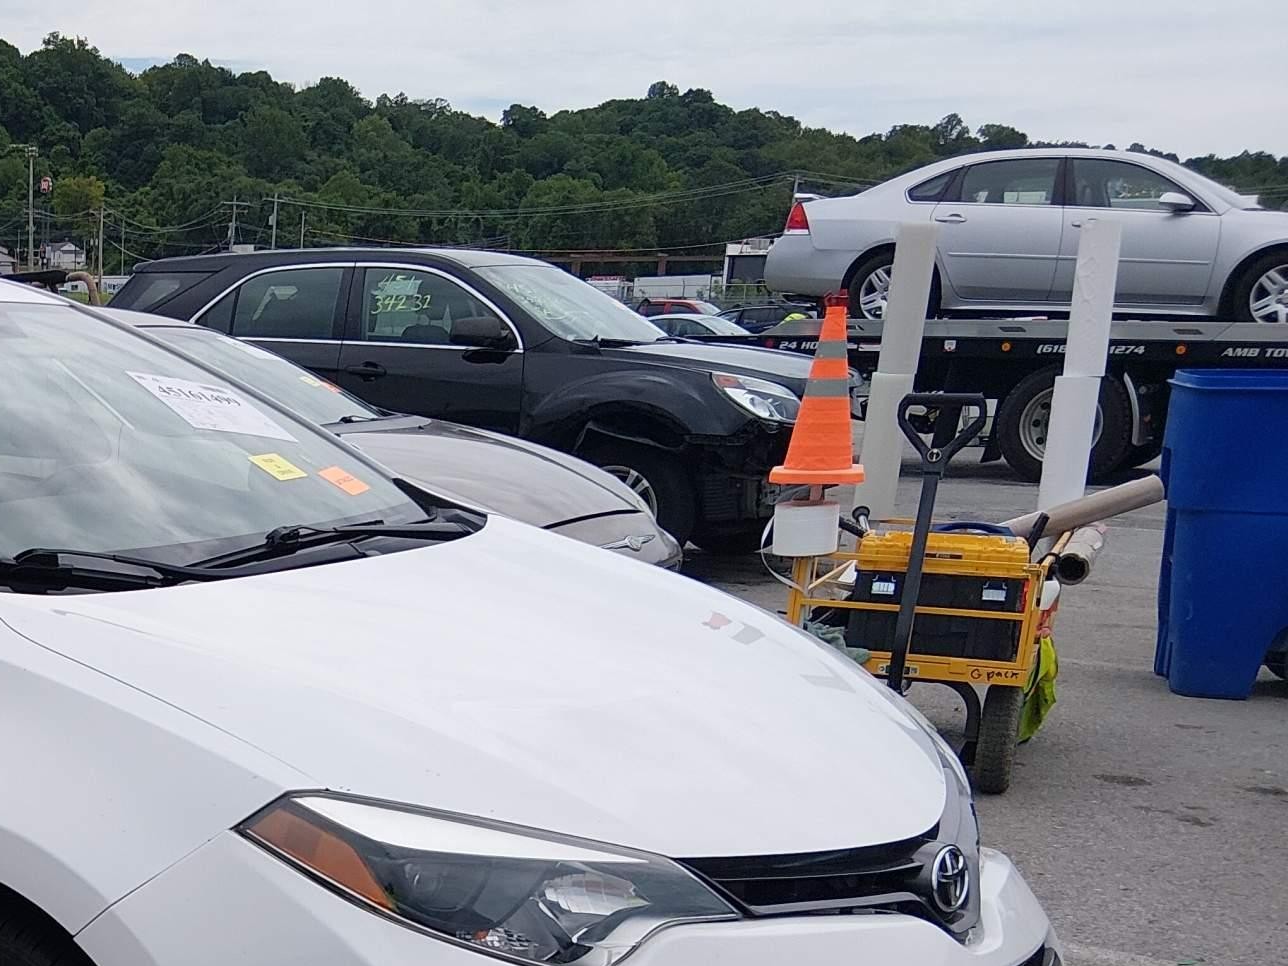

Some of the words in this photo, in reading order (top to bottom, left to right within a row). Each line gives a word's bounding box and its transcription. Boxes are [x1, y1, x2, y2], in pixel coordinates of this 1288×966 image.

[778, 341, 798, 350] 24
[800, 341, 819, 350] HO
[1221, 347, 1261, 357] AMB
[157, 384, 242, 407] 45161499
